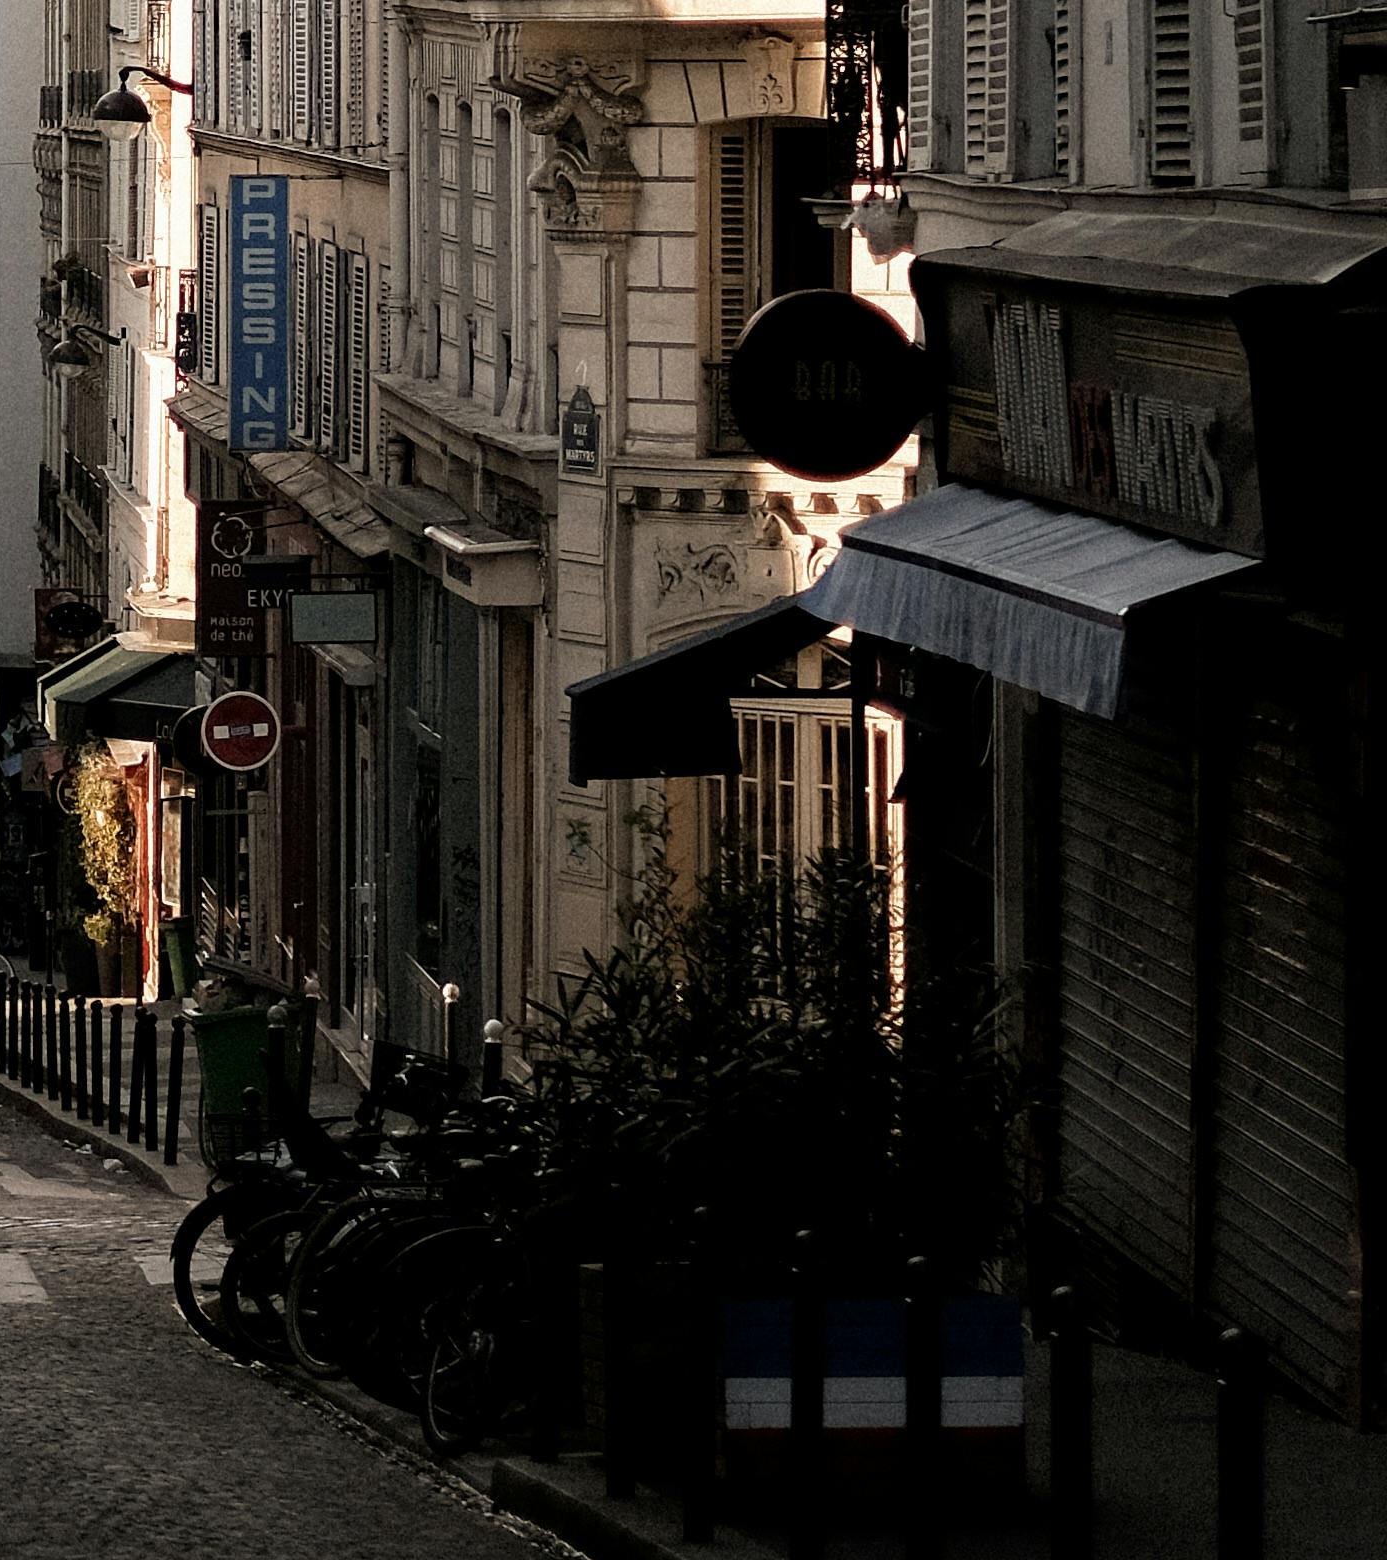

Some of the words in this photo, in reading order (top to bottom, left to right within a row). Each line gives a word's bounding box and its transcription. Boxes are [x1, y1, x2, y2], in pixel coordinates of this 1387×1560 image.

[241, 179, 276, 448] PRESSING
[1072, 380, 1115, 502] DES
[1109, 388, 1224, 529] MARTYRS
[210, 628, 226, 641] de
